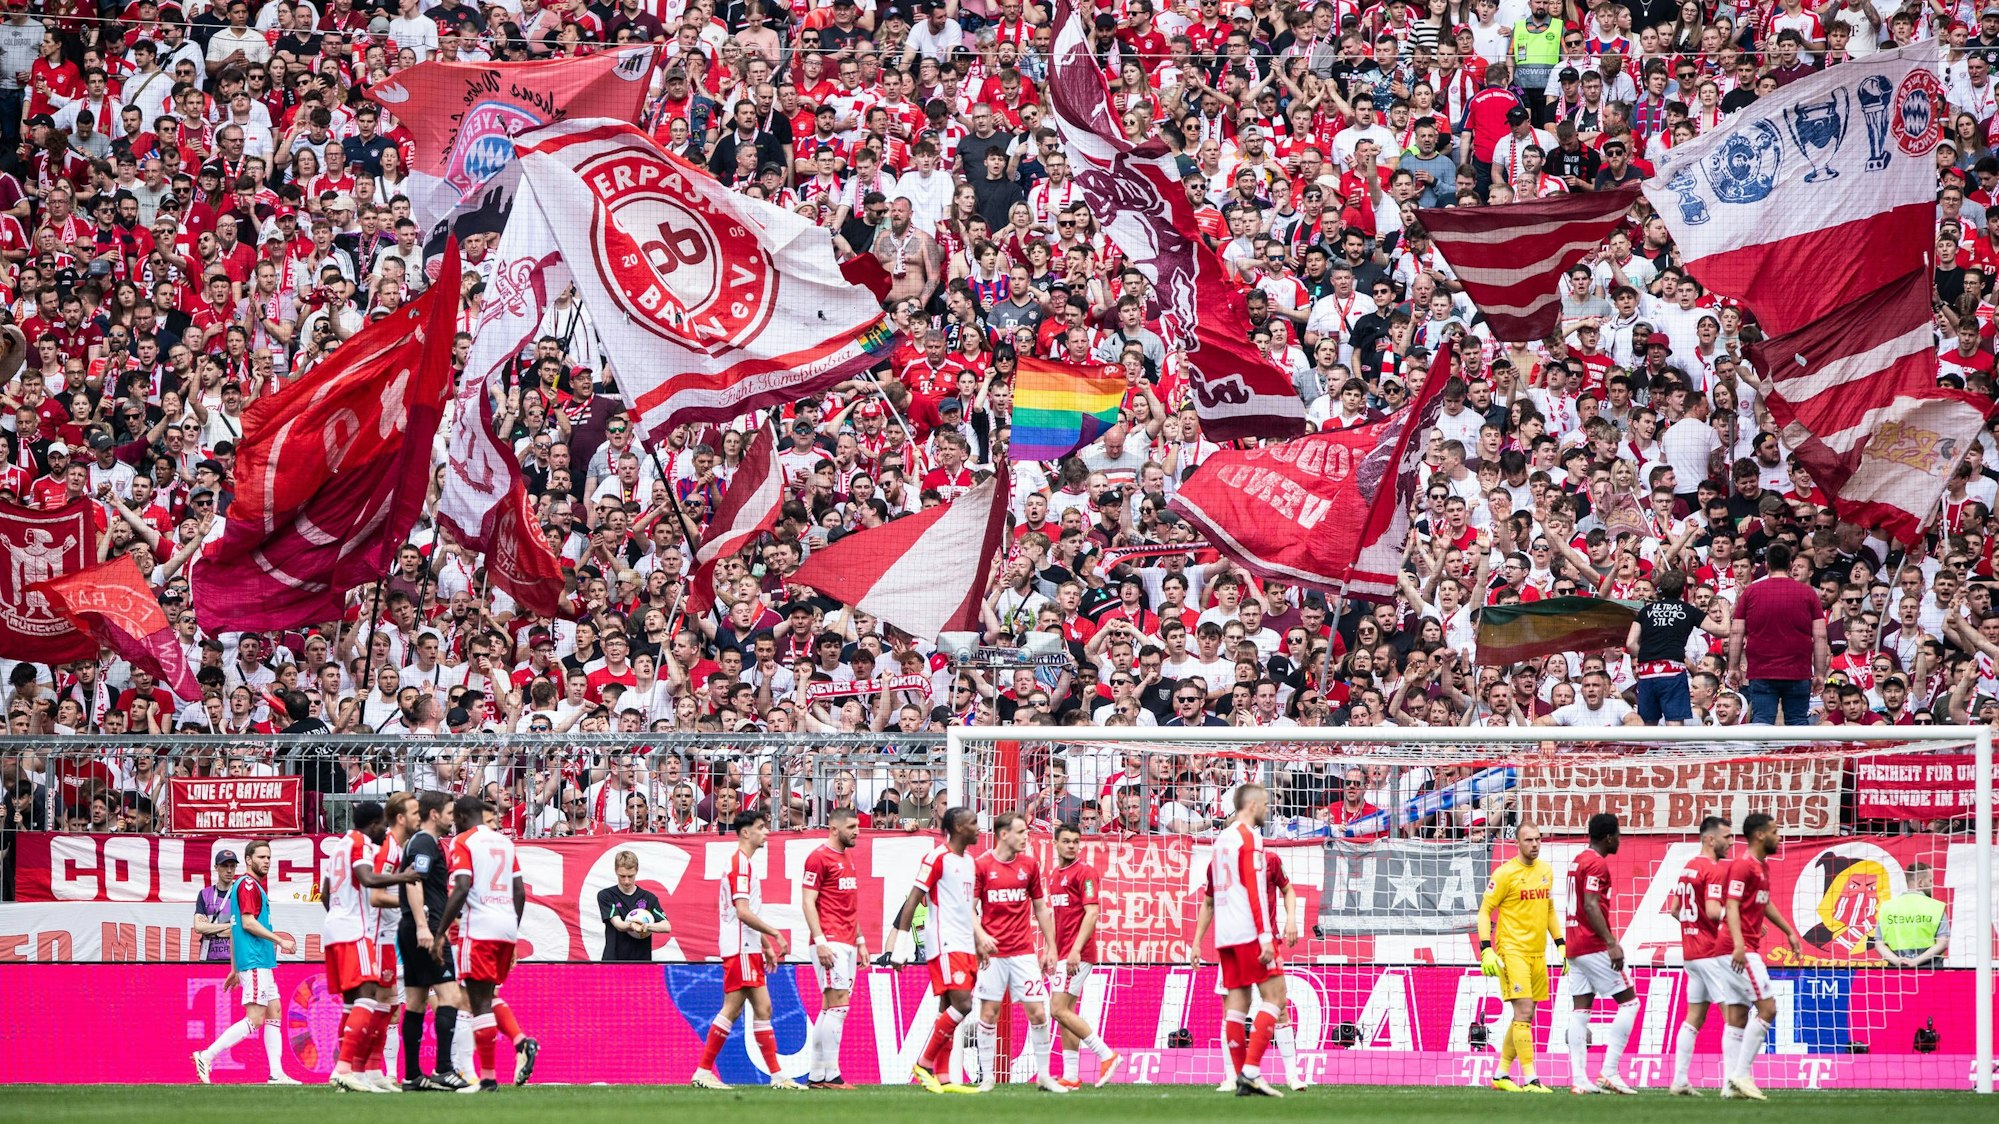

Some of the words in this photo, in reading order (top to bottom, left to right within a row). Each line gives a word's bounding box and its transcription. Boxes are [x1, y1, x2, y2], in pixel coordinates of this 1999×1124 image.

[729, 226, 745, 237] 06
[621, 254, 638, 268] 20
[718, 381, 754, 406] Fight
[1859, 764, 1922, 781] FREIHEIT
[1926, 762, 1953, 782] FÜR
[188, 784, 215, 800] LOVE
[218, 783, 233, 799] FC
[236, 782, 282, 799] BAYERN
[1860, 788, 1931, 806] FREUNDE
[1935, 789, 1953, 806] IM
[1521, 794, 1655, 827] IMMER
[196, 811, 225, 828] HATE
[228, 811, 273, 828] RACISM
[490, 848, 507, 891] 2
[987, 888, 1026, 903] REWE
[1521, 888, 1549, 900] REWE
[1024, 980, 1043, 996] 22
